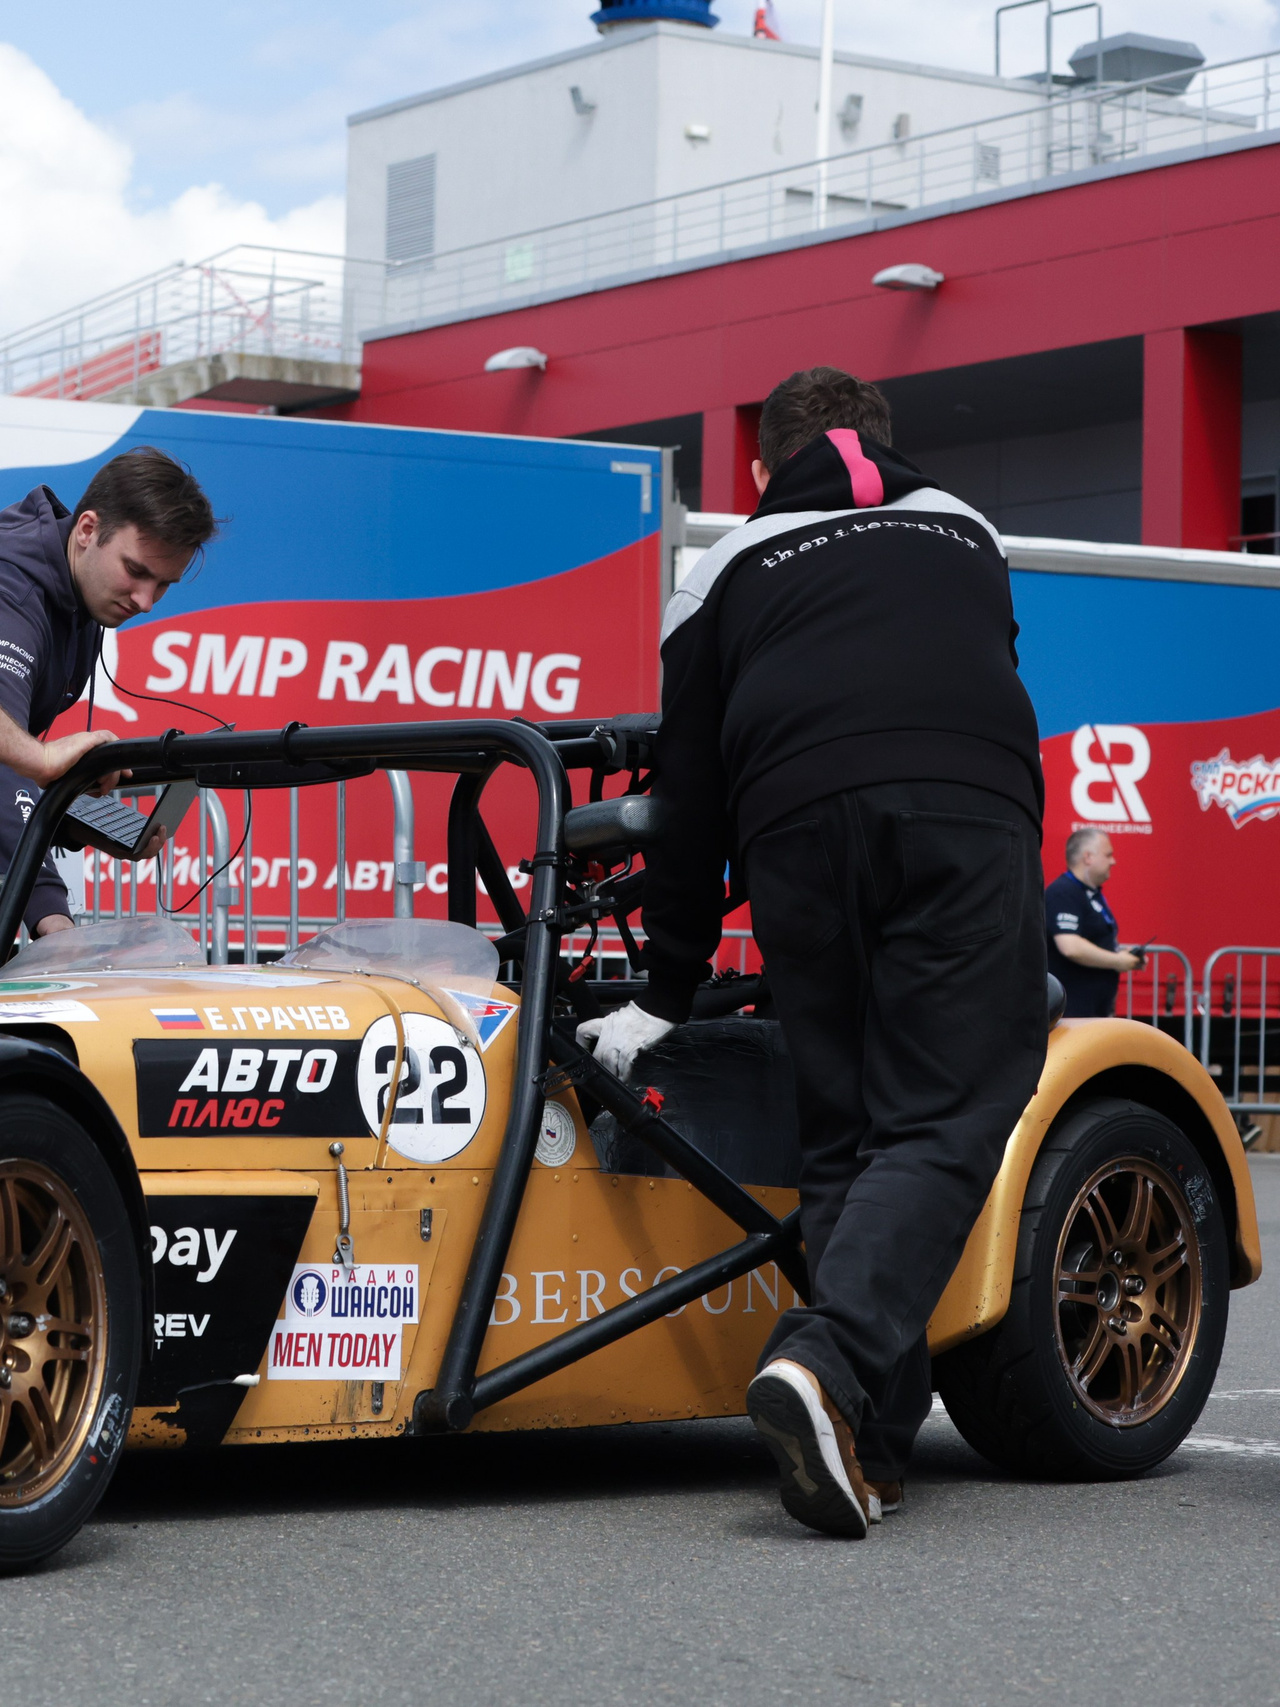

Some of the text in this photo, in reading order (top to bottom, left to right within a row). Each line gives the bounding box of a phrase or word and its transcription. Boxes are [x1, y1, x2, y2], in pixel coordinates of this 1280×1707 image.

[9, 643, 35, 664] RACING
[146, 631, 582, 714] SMP RACING
[204, 1005, 350, 1031] Е.ГРАЧЕВ
[178, 1048, 337, 1093] АВТО
[375, 1045, 471, 1124] 22
[168, 1099, 285, 1128] ПЛЮС
[332, 1270, 414, 1286] РАДИО
[331, 1286, 414, 1318] ШАНСОН
[273, 1332, 397, 1367] MEN TODAY
